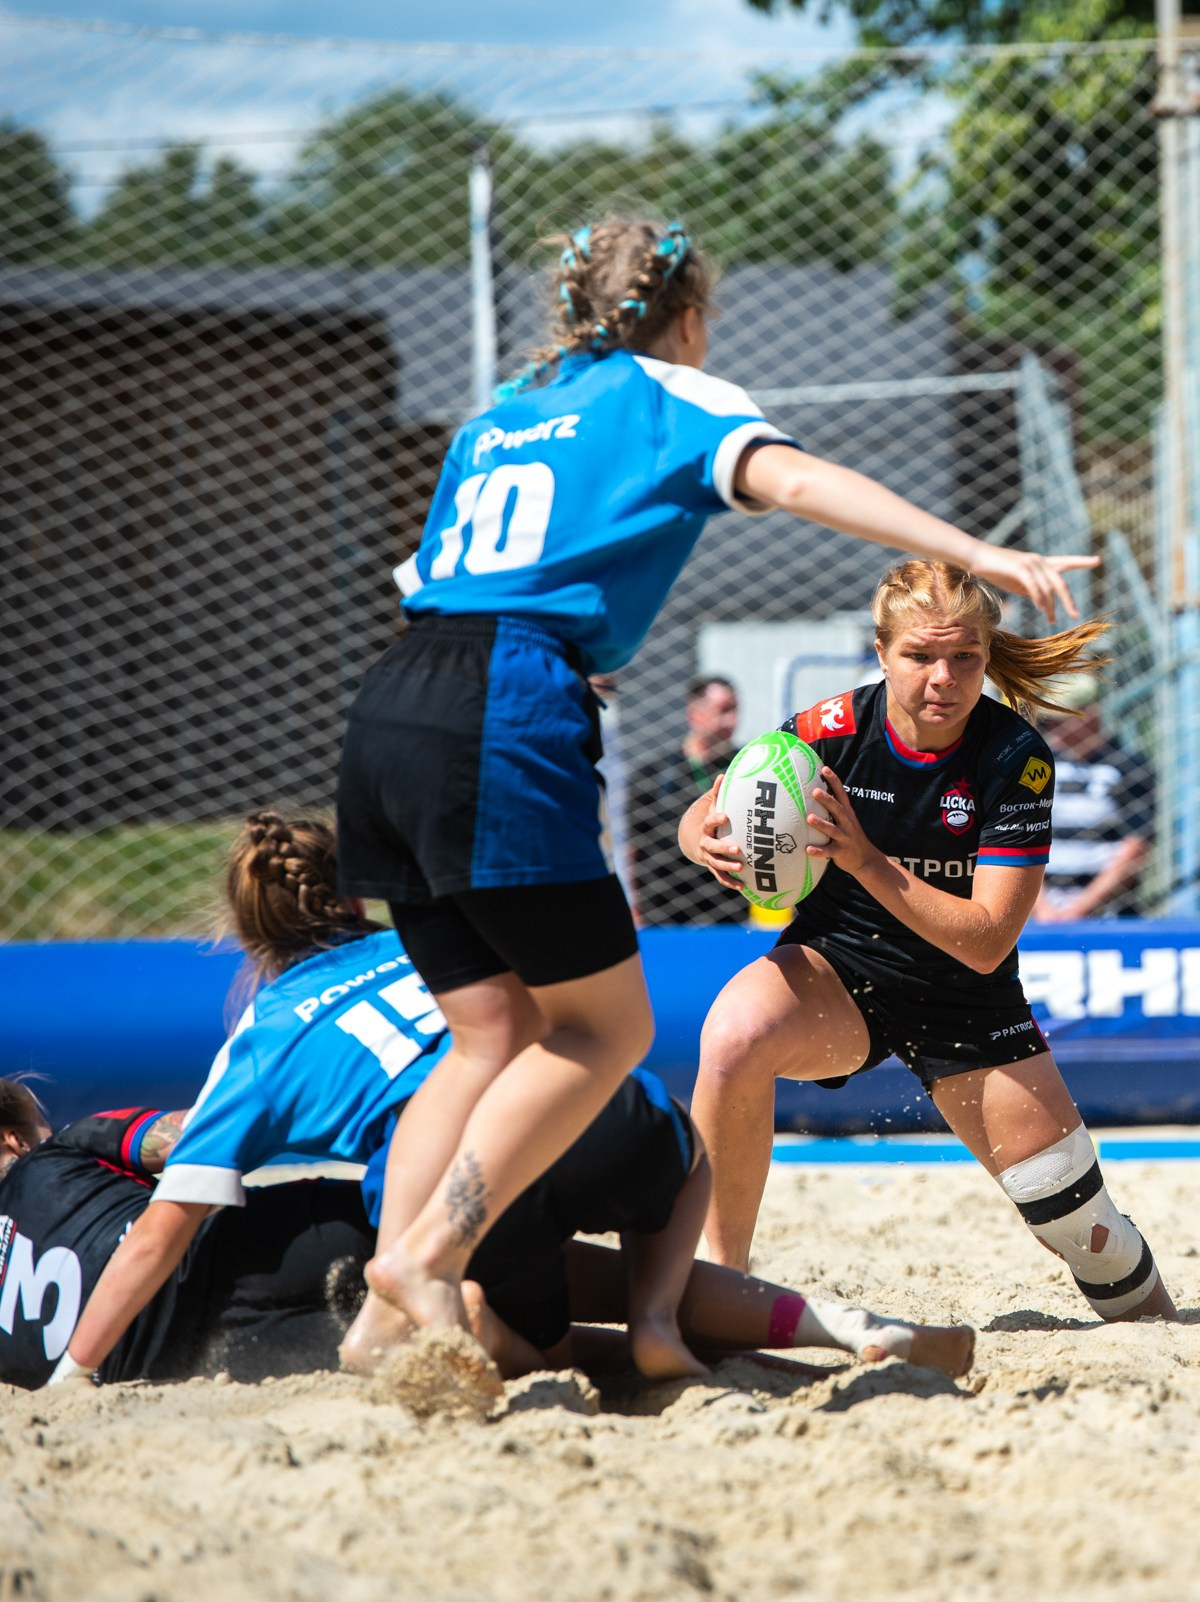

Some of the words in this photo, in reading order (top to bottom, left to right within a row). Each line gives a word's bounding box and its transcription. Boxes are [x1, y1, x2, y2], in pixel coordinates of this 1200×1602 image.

[430, 461, 555, 580] 10
[852, 786, 895, 803] PATRICK
[940, 796, 976, 811] ЦСКА
[754, 781, 777, 893] RHINO
[747, 853, 753, 868] XV
[1001, 1019, 1034, 1037] PATRICK
[0, 1231, 82, 1361] 3
